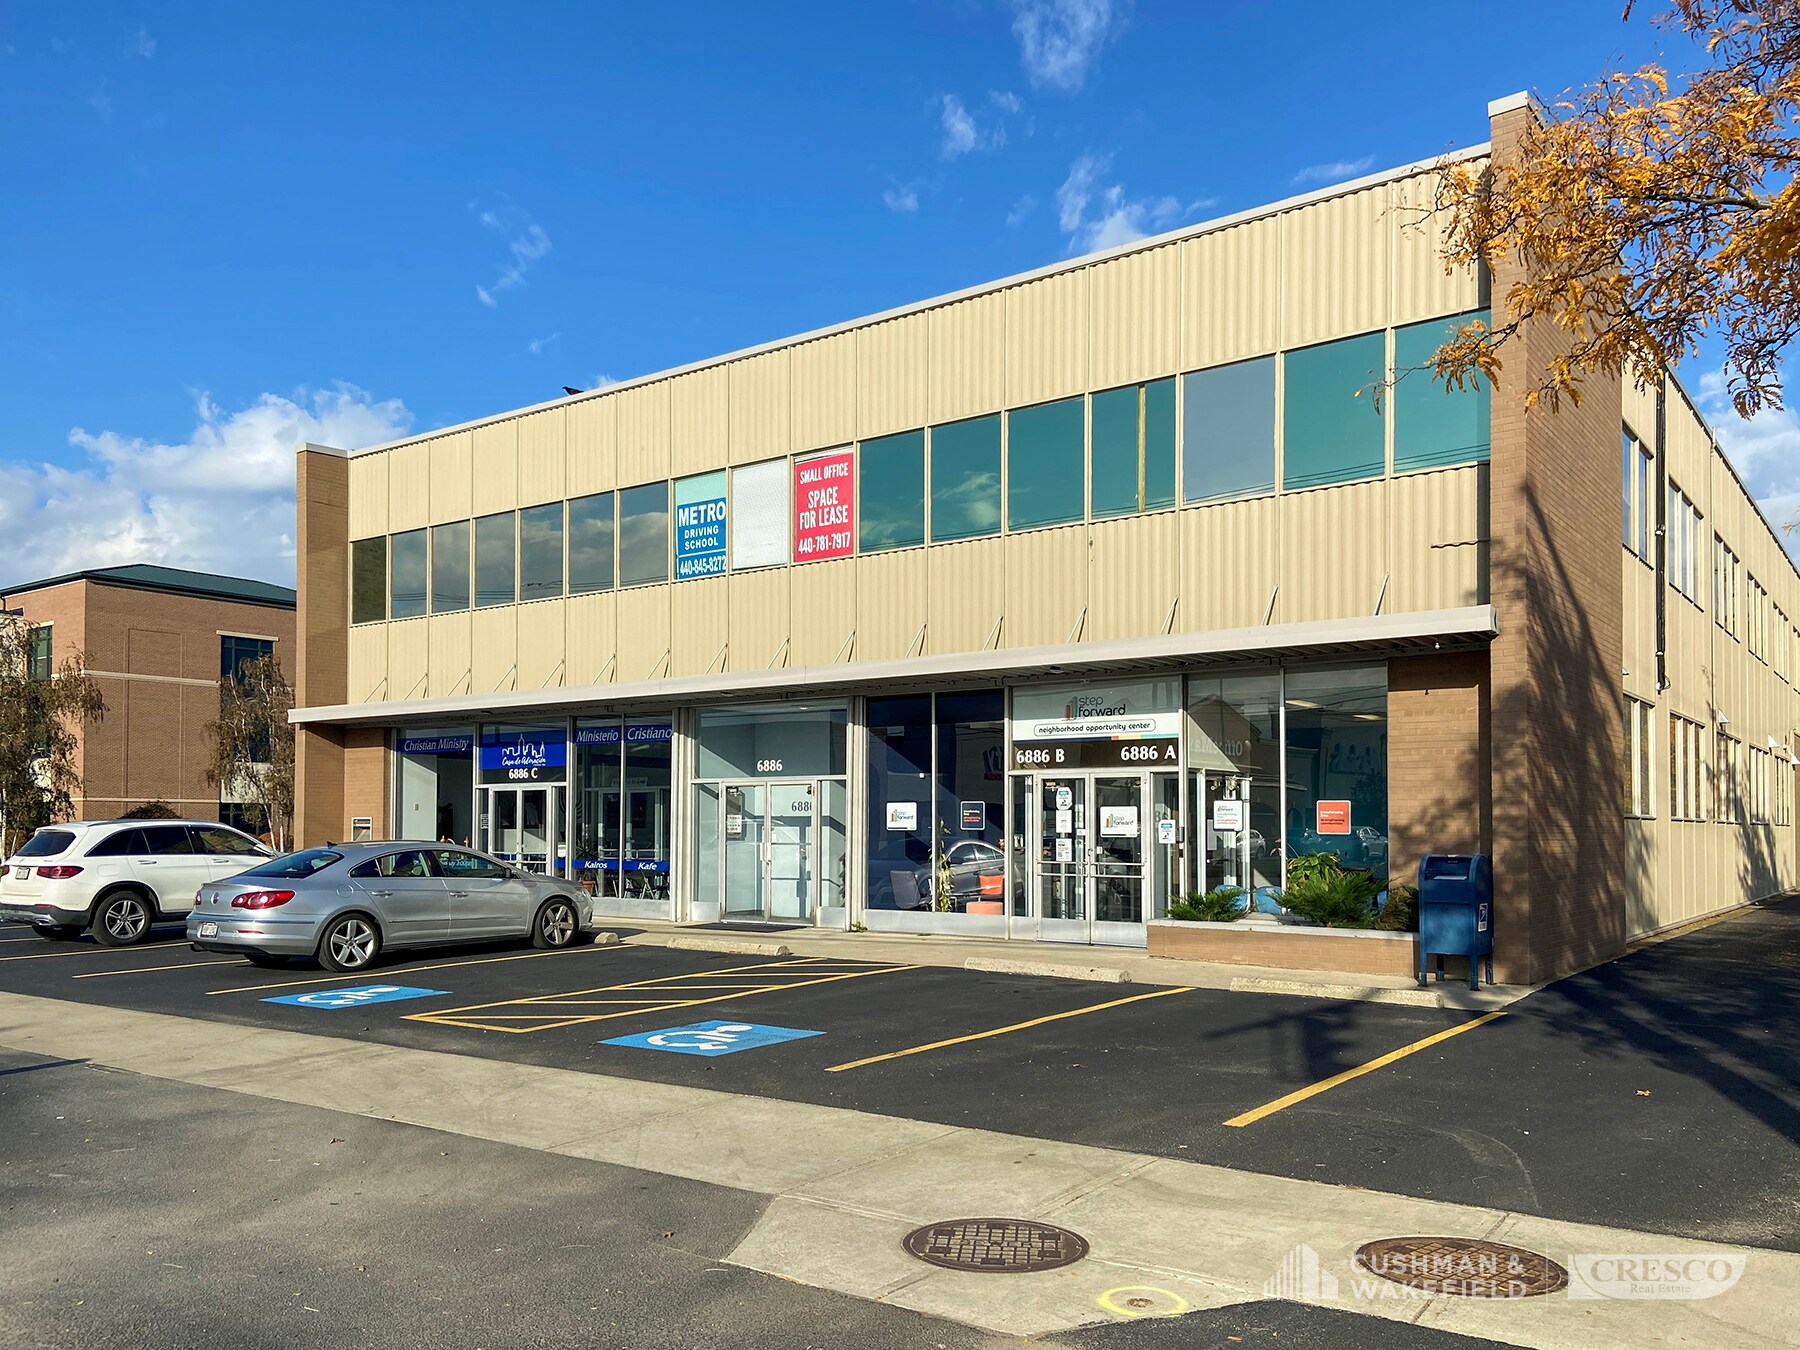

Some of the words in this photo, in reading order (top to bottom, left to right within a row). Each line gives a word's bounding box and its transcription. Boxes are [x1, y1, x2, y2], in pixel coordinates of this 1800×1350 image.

[799, 468, 822, 484] SMALL
[823, 462, 848, 480] OFFICE
[808, 486, 838, 509] SPACE
[678, 501, 726, 527] METRO
[799, 511, 816, 530] FOR
[818, 505, 848, 527] LEASE
[684, 525, 719, 539] DRIVING
[684, 536, 719, 550] SCHOOL
[798, 532, 850, 554] 440-781-7917
[680, 555, 726, 576] 440-845-8272
[1078, 695, 1104, 707] step
[1078, 704, 1126, 718] forward
[576, 730, 618, 743] Ministerio
[627, 727, 672, 740] Cristiano
[1039, 724, 1084, 734] neighborhood
[1086, 723, 1126, 732] opportunity
[1128, 722, 1151, 730] center
[404, 739, 436, 752] Christian
[437, 737, 469, 751] Ministry
[1016, 749, 1050, 764] 6886
[1055, 748, 1065, 763] B
[1120, 745, 1158, 761] 6886
[1164, 744, 1176, 759] A
[509, 768, 529, 779] 6886
[531, 767, 538, 779] C
[756, 759, 783, 772] 6886
[584, 860, 608, 869] Kairos
[637, 861, 657, 871] Kafe
